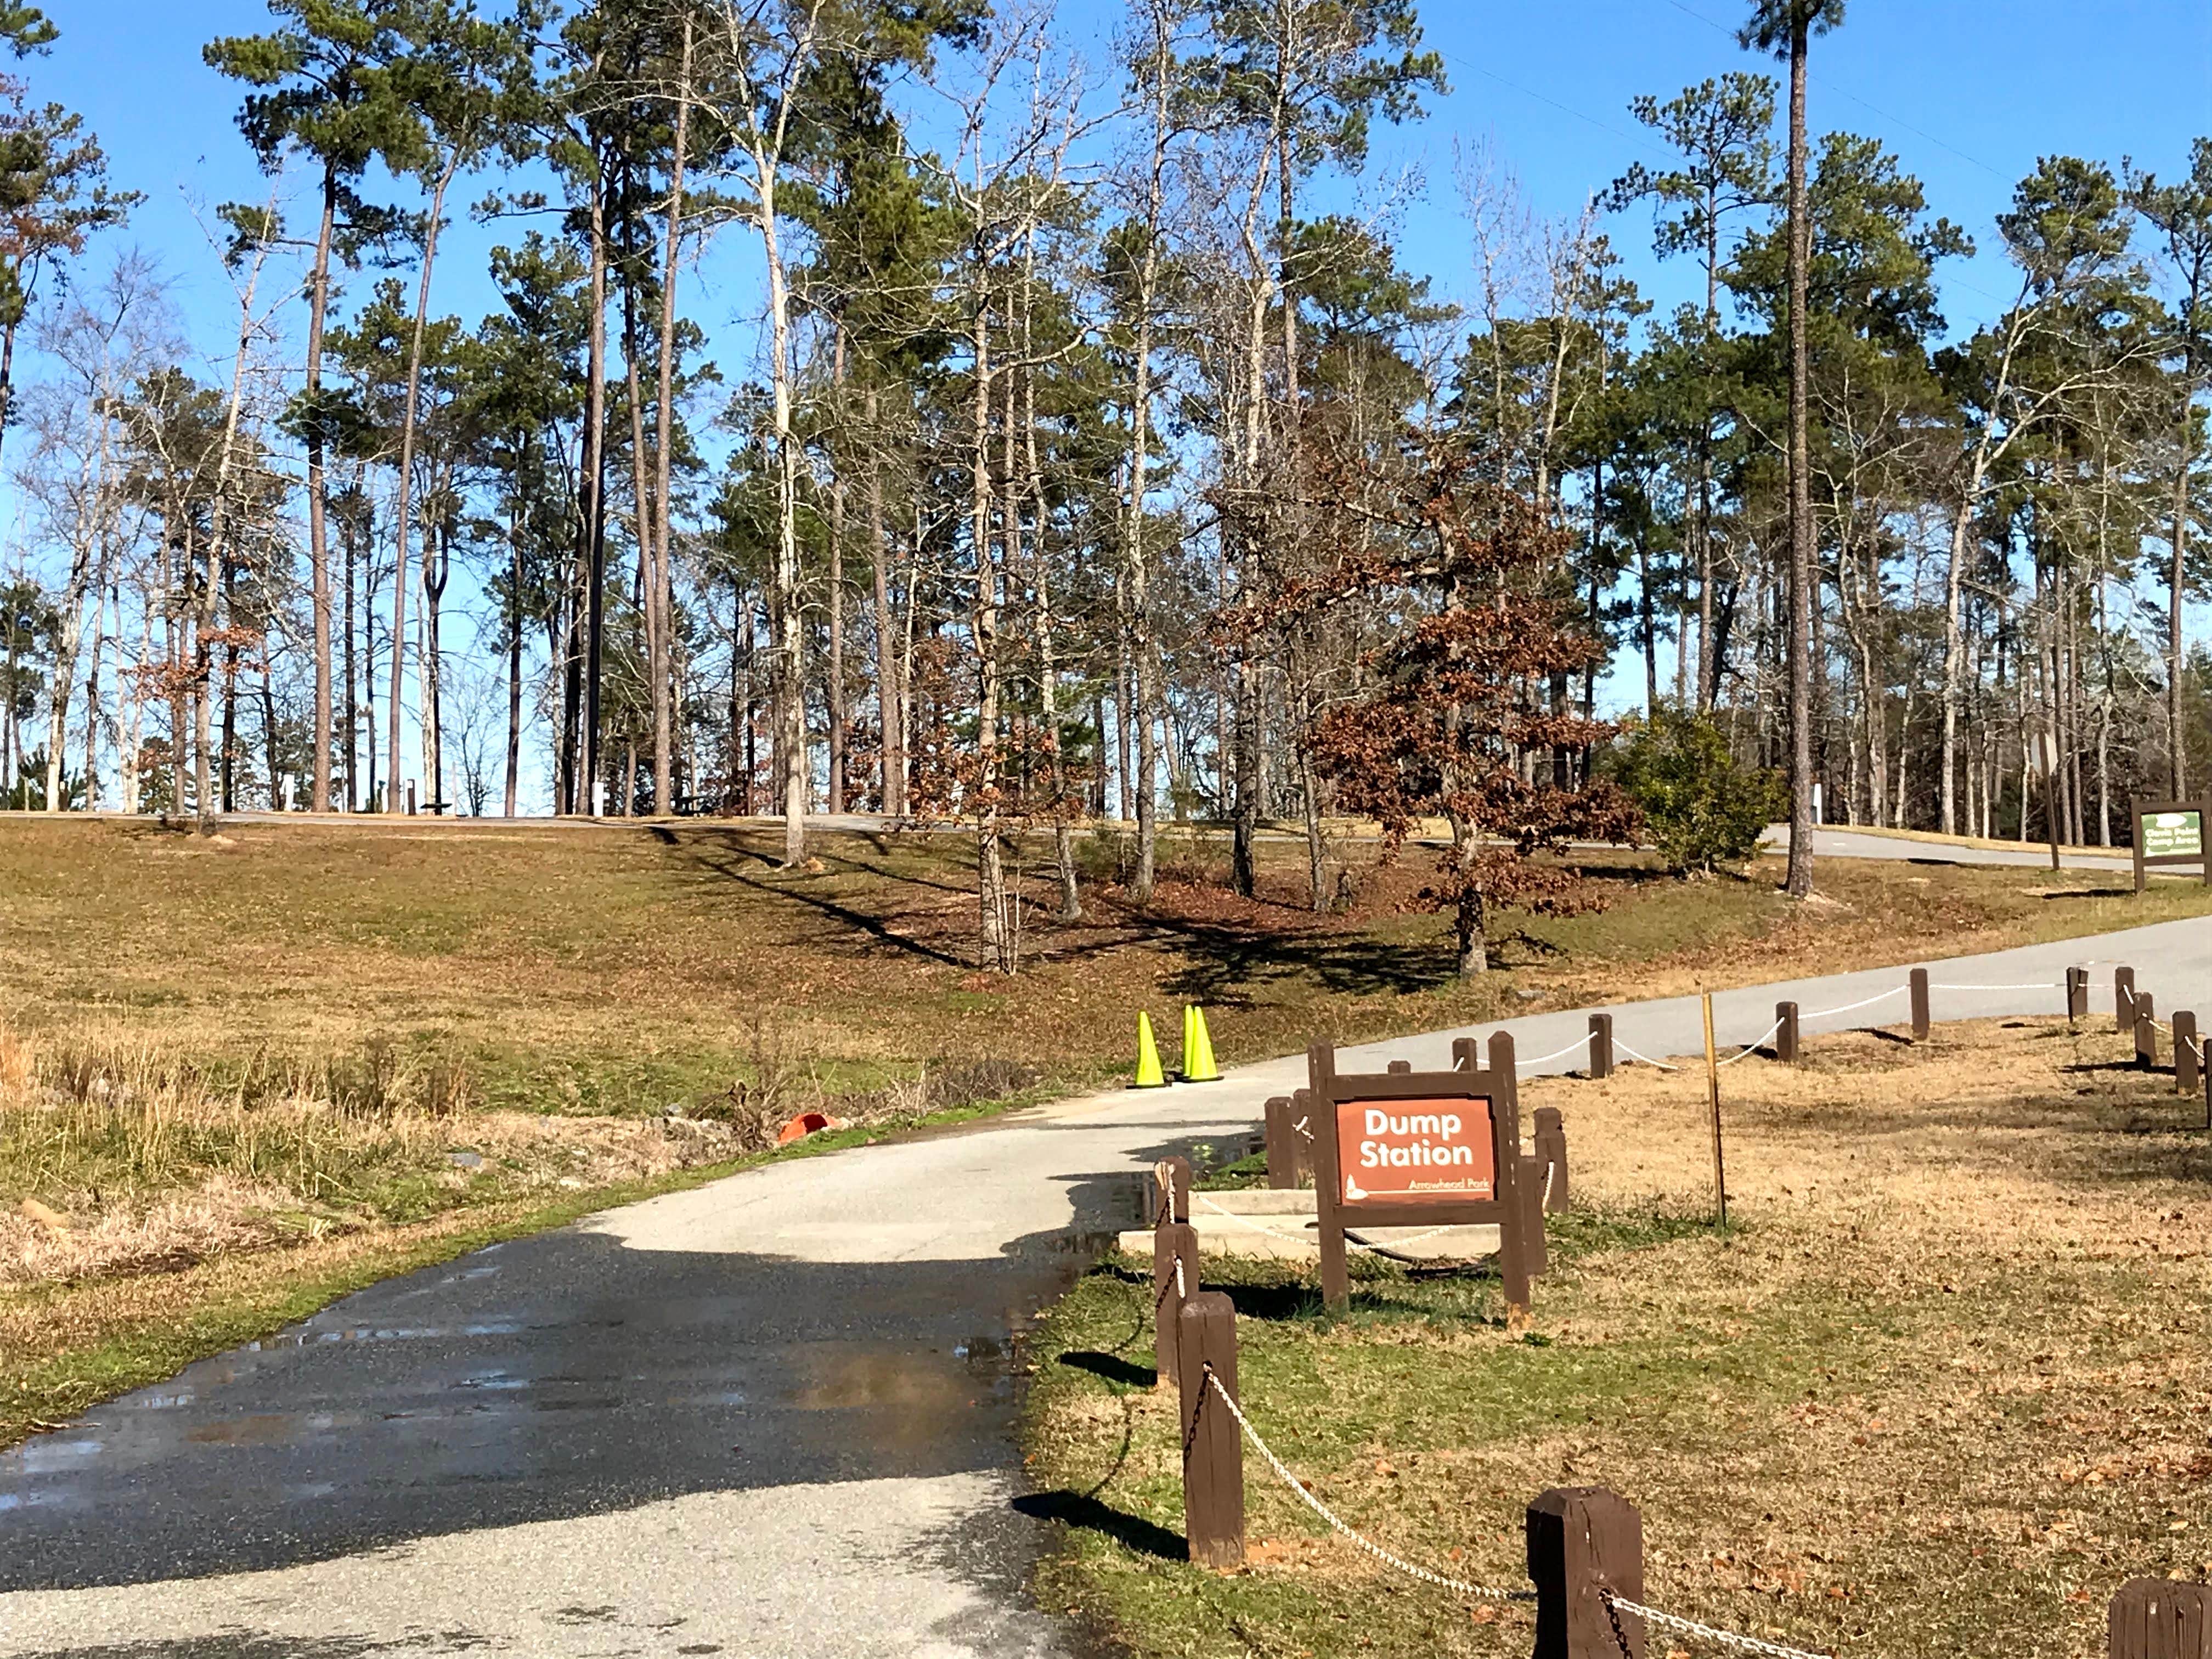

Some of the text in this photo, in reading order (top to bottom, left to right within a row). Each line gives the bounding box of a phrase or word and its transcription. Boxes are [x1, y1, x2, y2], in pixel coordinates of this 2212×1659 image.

[2146, 838, 2174, 847] Camp
[1364, 1108, 1462, 1141] Dump
[1359, 1139, 1474, 1168] Station
[1409, 1177, 1490, 1190] Arrowhead Park
